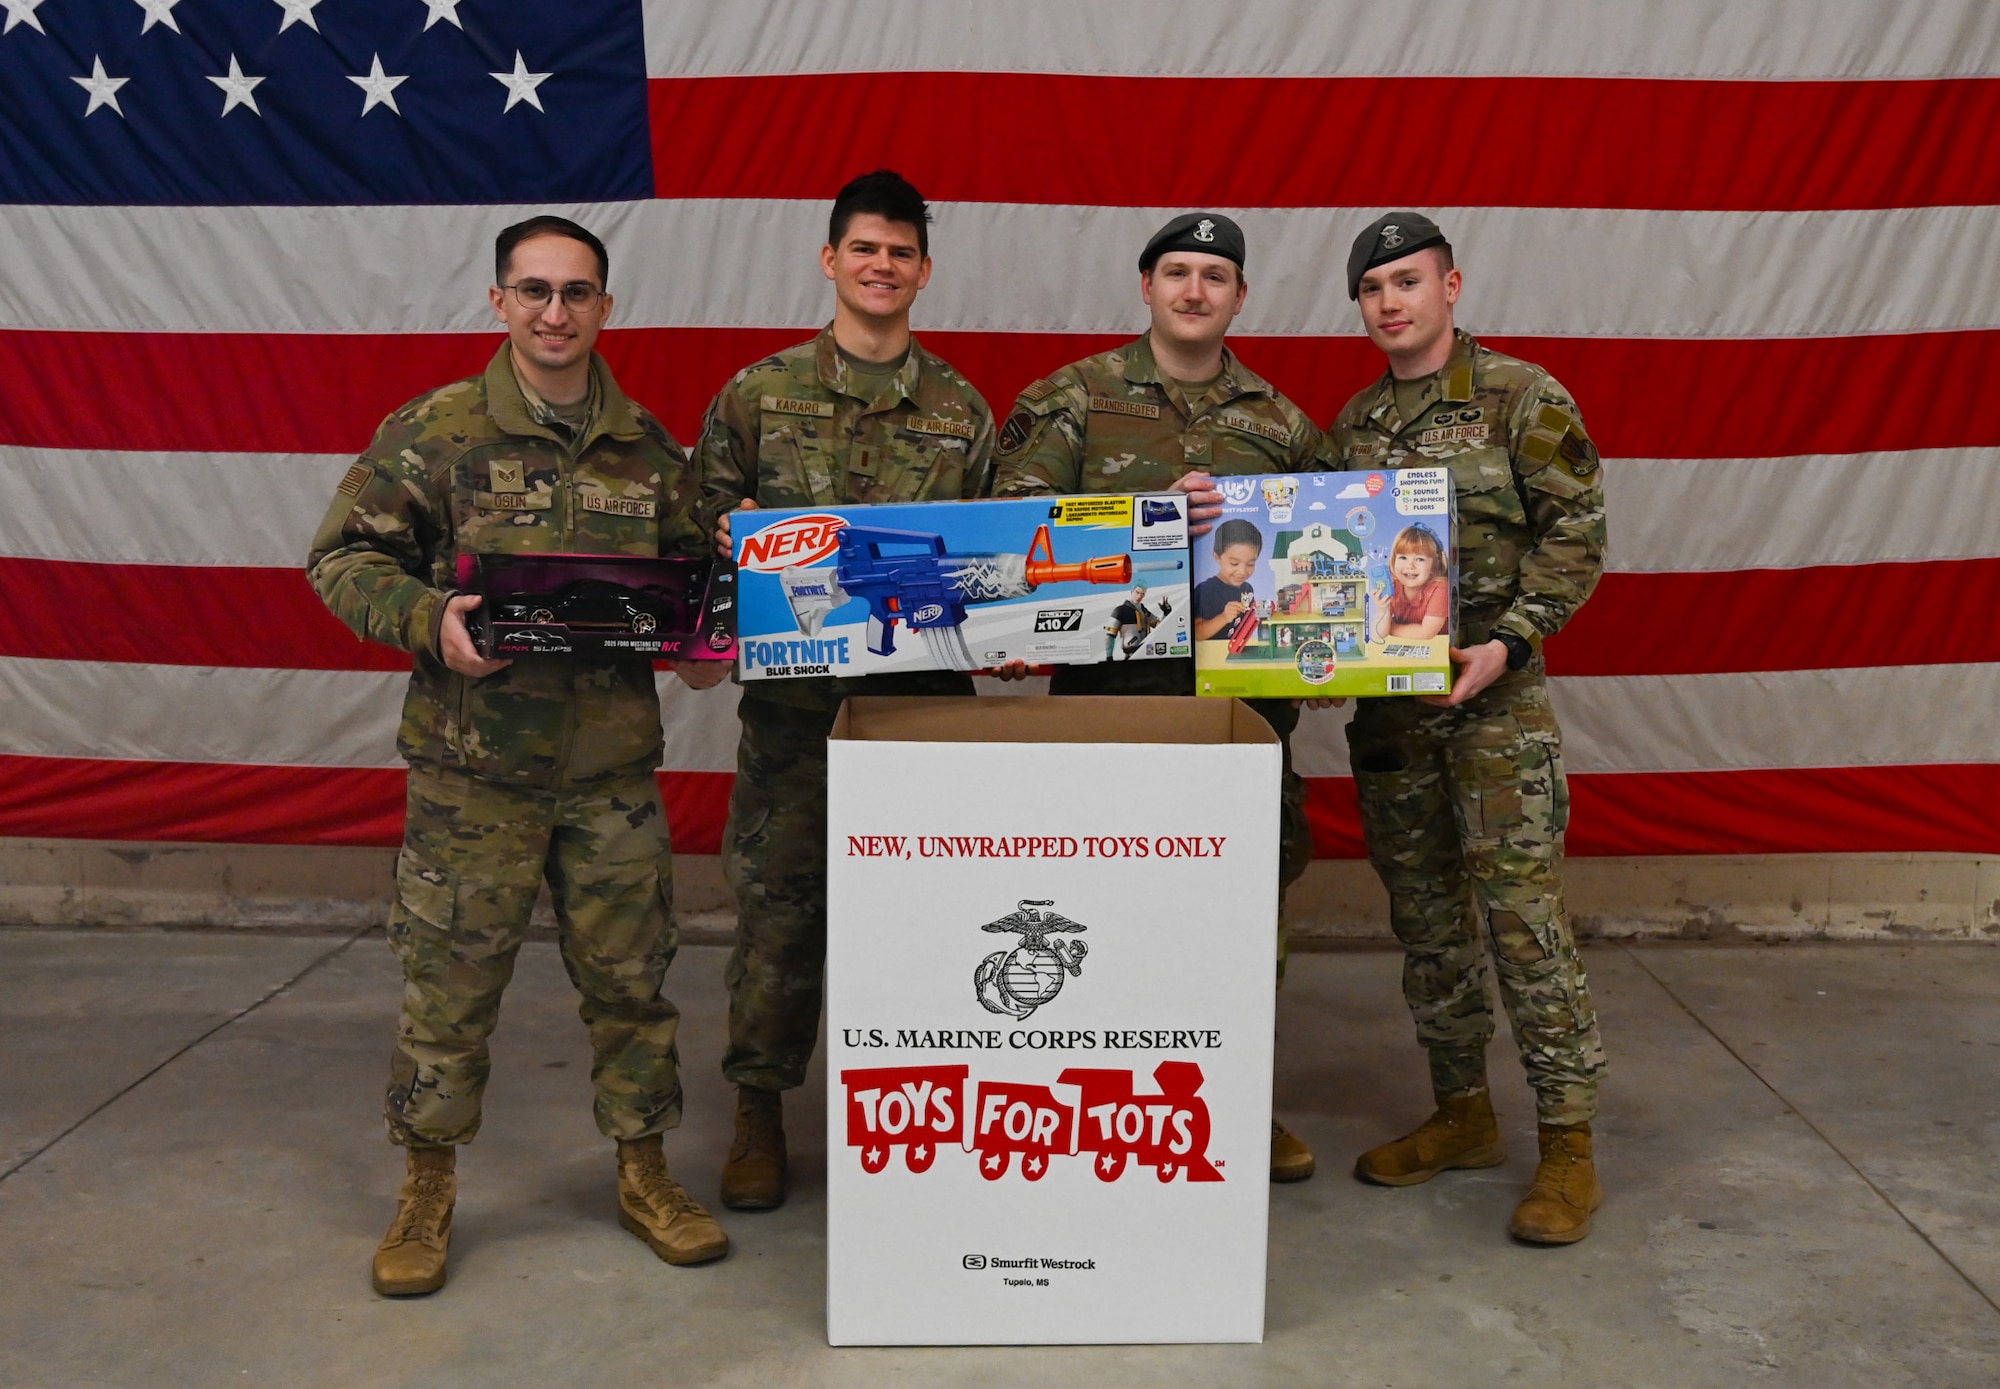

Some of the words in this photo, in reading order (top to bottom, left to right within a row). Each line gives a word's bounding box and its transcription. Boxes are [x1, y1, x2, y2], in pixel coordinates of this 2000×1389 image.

[775, 398, 820, 414] KARARO
[1092, 398, 1157, 417] BRANDSTEDTER
[925, 420, 942, 432] AIR
[943, 422, 973, 437] FORCE
[1247, 421, 1261, 434] AIR
[1262, 425, 1290, 445] FORCE
[1424, 431, 1439, 443] U.S.
[1441, 428, 1454, 440] AIR
[1455, 426, 1485, 439] FORCE
[494, 495, 527, 509] OSLIN
[604, 500, 620, 513] AIR
[620, 501, 651, 516] FORCE
[739, 521, 844, 569] NERF
[790, 584, 829, 598] FORTNITE
[712, 601, 733, 613] USB
[913, 606, 942, 623] NERF
[1037, 618, 1062, 631] x10
[532, 645, 573, 653] SLIPS
[661, 641, 682, 652] R/C
[744, 637, 850, 670] FORTNITE
[766, 667, 792, 677] BLUE
[793, 665, 830, 675] SHOCK
[847, 835, 912, 861] NEW,
[917, 836, 1078, 858] UNWRAPPED
[1083, 836, 1149, 858] TOYS
[1155, 836, 1227, 858] ONLY
[842, 1029, 889, 1048] U.S.
[895, 1029, 1003, 1049] MARINE
[1008, 1030, 1097, 1049] CORPS
[1103, 1030, 1223, 1049] RESERVE
[853, 1079, 956, 1135] TOYS
[979, 1094, 1061, 1147] FOR
[1087, 1102, 1194, 1156] TOTS
[990, 1257, 1039, 1269] Smurfit
[1040, 1258, 1096, 1270] Westrock
[1003, 1278, 1034, 1287] Tupelo,
[1036, 1278, 1050, 1287] MS
